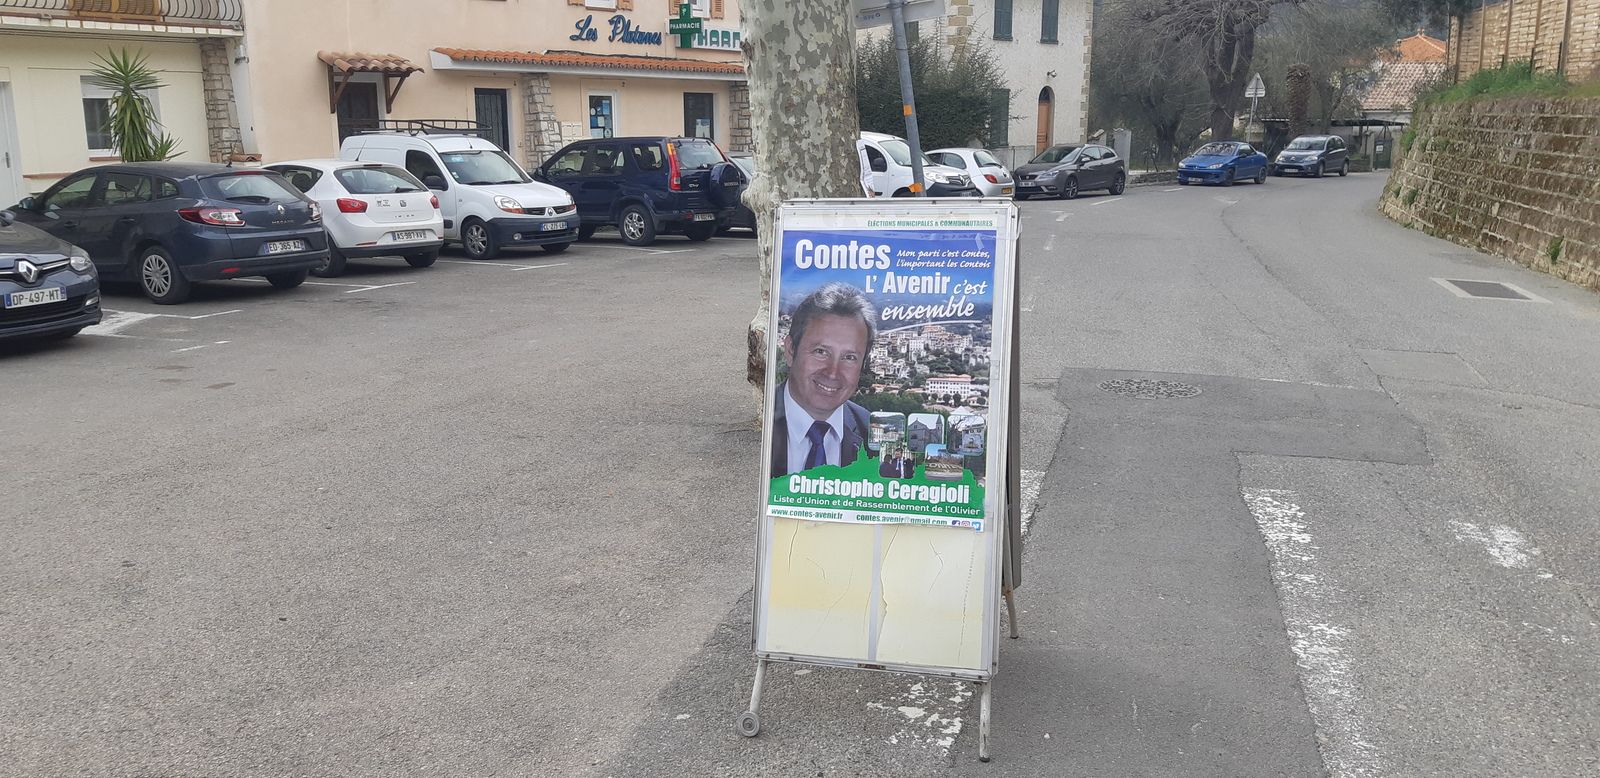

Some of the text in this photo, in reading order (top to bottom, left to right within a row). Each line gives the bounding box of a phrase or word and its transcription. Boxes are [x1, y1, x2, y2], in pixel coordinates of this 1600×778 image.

[570, 14, 662, 46] Les Platanes
[670, 22, 700, 30] PHARMACIE
[897, 219, 933, 227] MUNICIPALES
[940, 219, 993, 227] COMMUNAUTAIRES
[795, 239, 891, 270] Contes
[896, 249, 991, 261] Mon parti c'est Contes,
[896, 259, 991, 270] l'important les Contois
[882, 271, 951, 294] Avenir
[953, 279, 988, 296] c'est
[881, 295, 975, 321] ensemble
[789, 474, 970, 504] Christophe Ceragioli
[771, 508, 843, 520] www.contes-avenir.fr
[773, 494, 795, 503] Liste
[796, 496, 830, 506] d'Union
[843, 499, 853, 507] de
[856, 500, 929, 512] Rassemblement
[931, 504, 943, 513] de
[945, 505, 981, 516] l'Olivier
